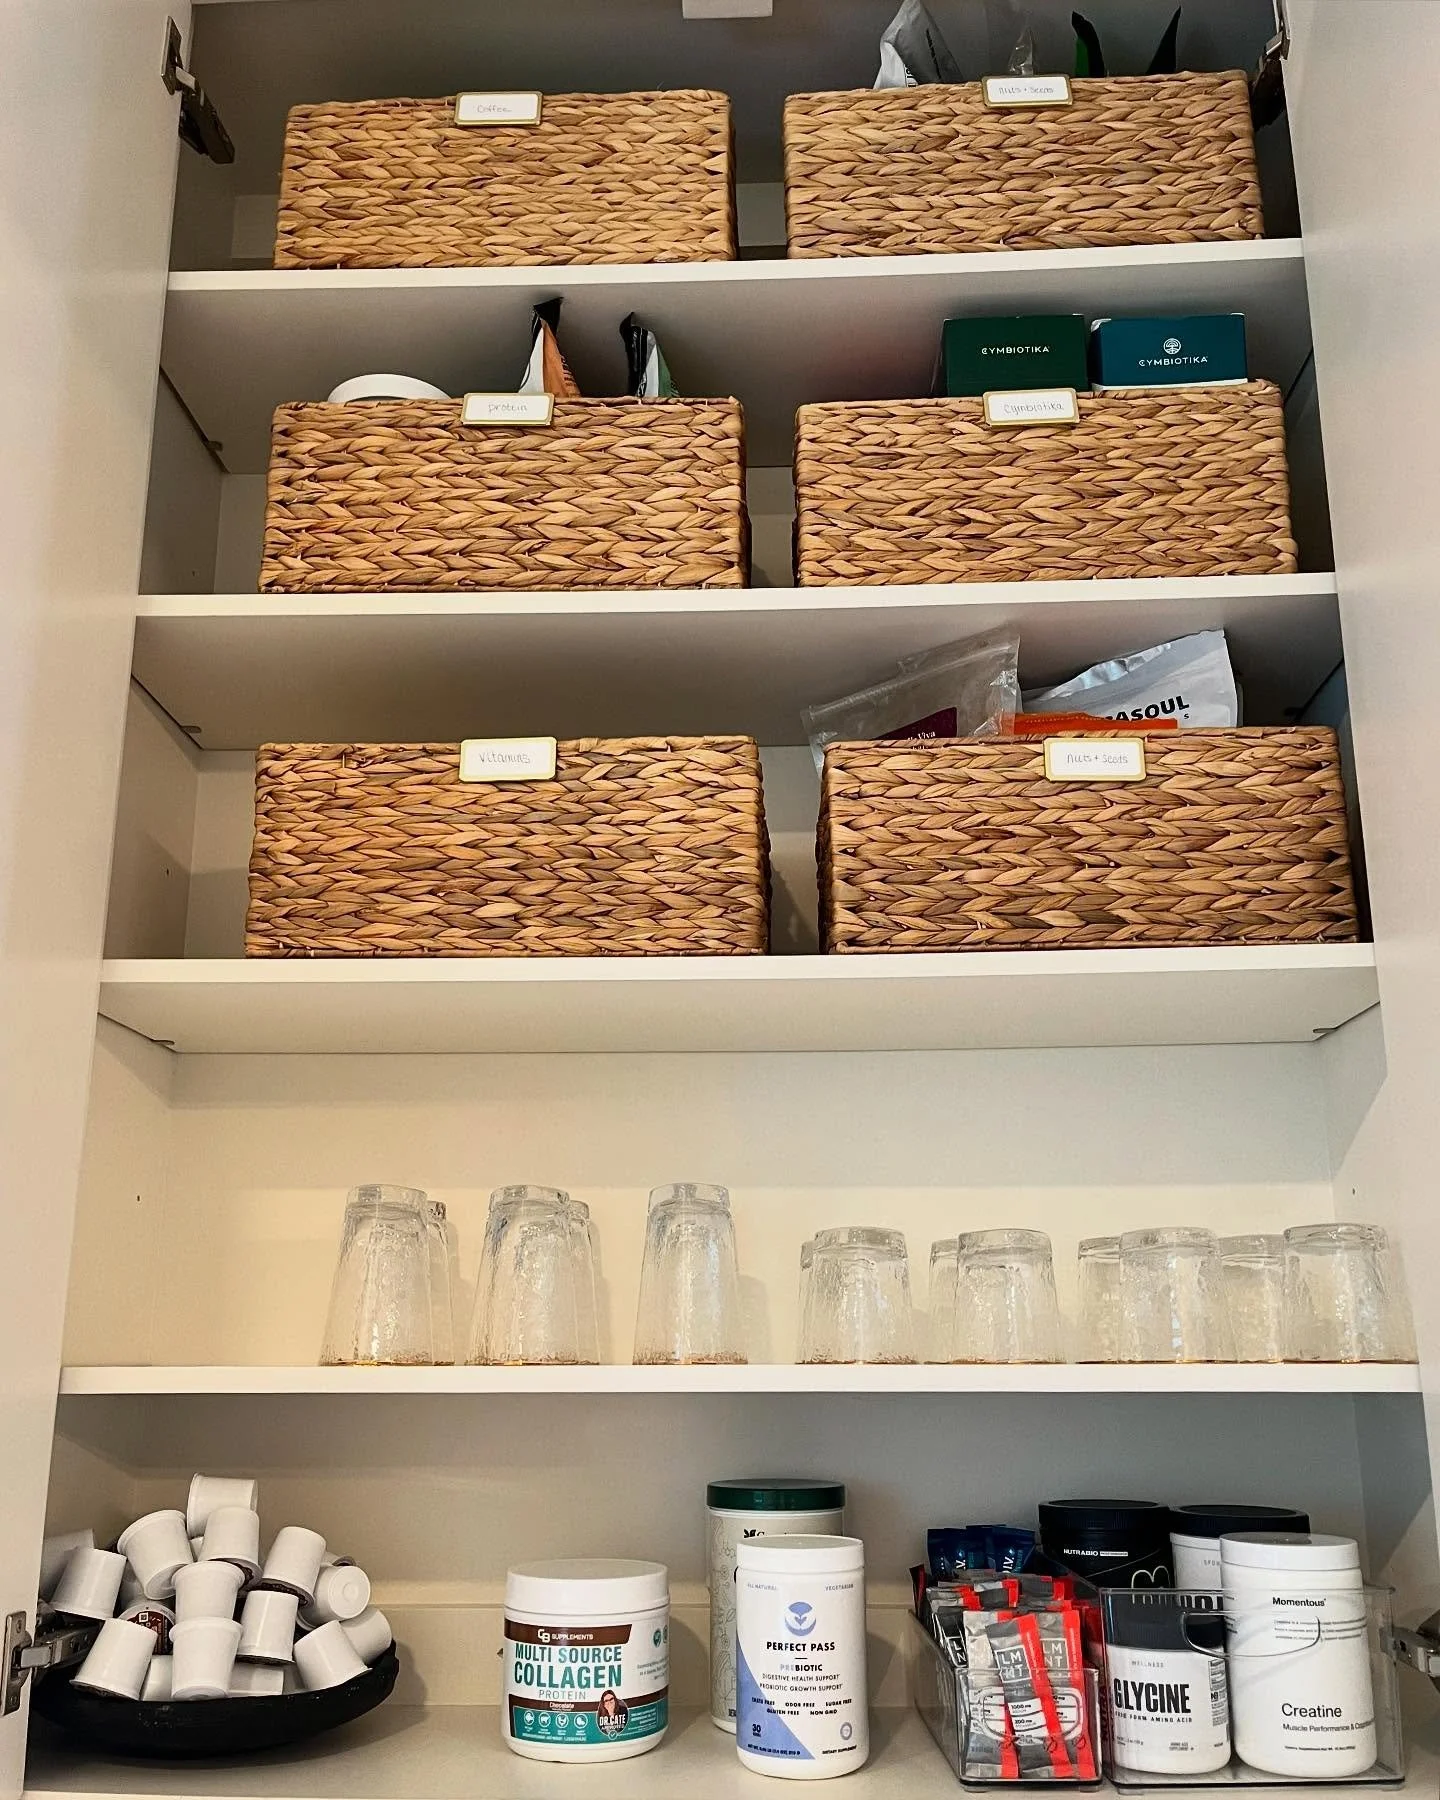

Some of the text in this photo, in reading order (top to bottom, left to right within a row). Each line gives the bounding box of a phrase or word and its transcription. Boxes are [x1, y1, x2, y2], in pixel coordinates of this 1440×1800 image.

[981, 345, 1049, 354] CYMBIOTIKA
[1138, 356, 1208, 367] CYMBIOTIKA
[1105, 695, 1190, 722] ASOUL
[1063, 1548, 1099, 1557] NUTRABIO
[1272, 1597, 1326, 1607] Momentous
[766, 1641, 836, 1652] PERFECT PASS
[515, 1643, 622, 1664] MULTI SOURCE
[780, 1663, 823, 1672] PREBIOTIC
[514, 1661, 622, 1689] COLLAGEN
[762, 1673, 790, 1681] DIGESTIVE
[760, 1683, 788, 1692] PROBIOTIC
[789, 1684, 817, 1692] GROWTH
[538, 1690, 586, 1700] PROTEIN
[1113, 1677, 1192, 1714] GLYCINE
[1281, 1702, 1342, 1718] Creatine
[752, 1723, 762, 1733] 30
[1282, 1723, 1308, 1732] Muscle
[1309, 1724, 1350, 1732] Performance
